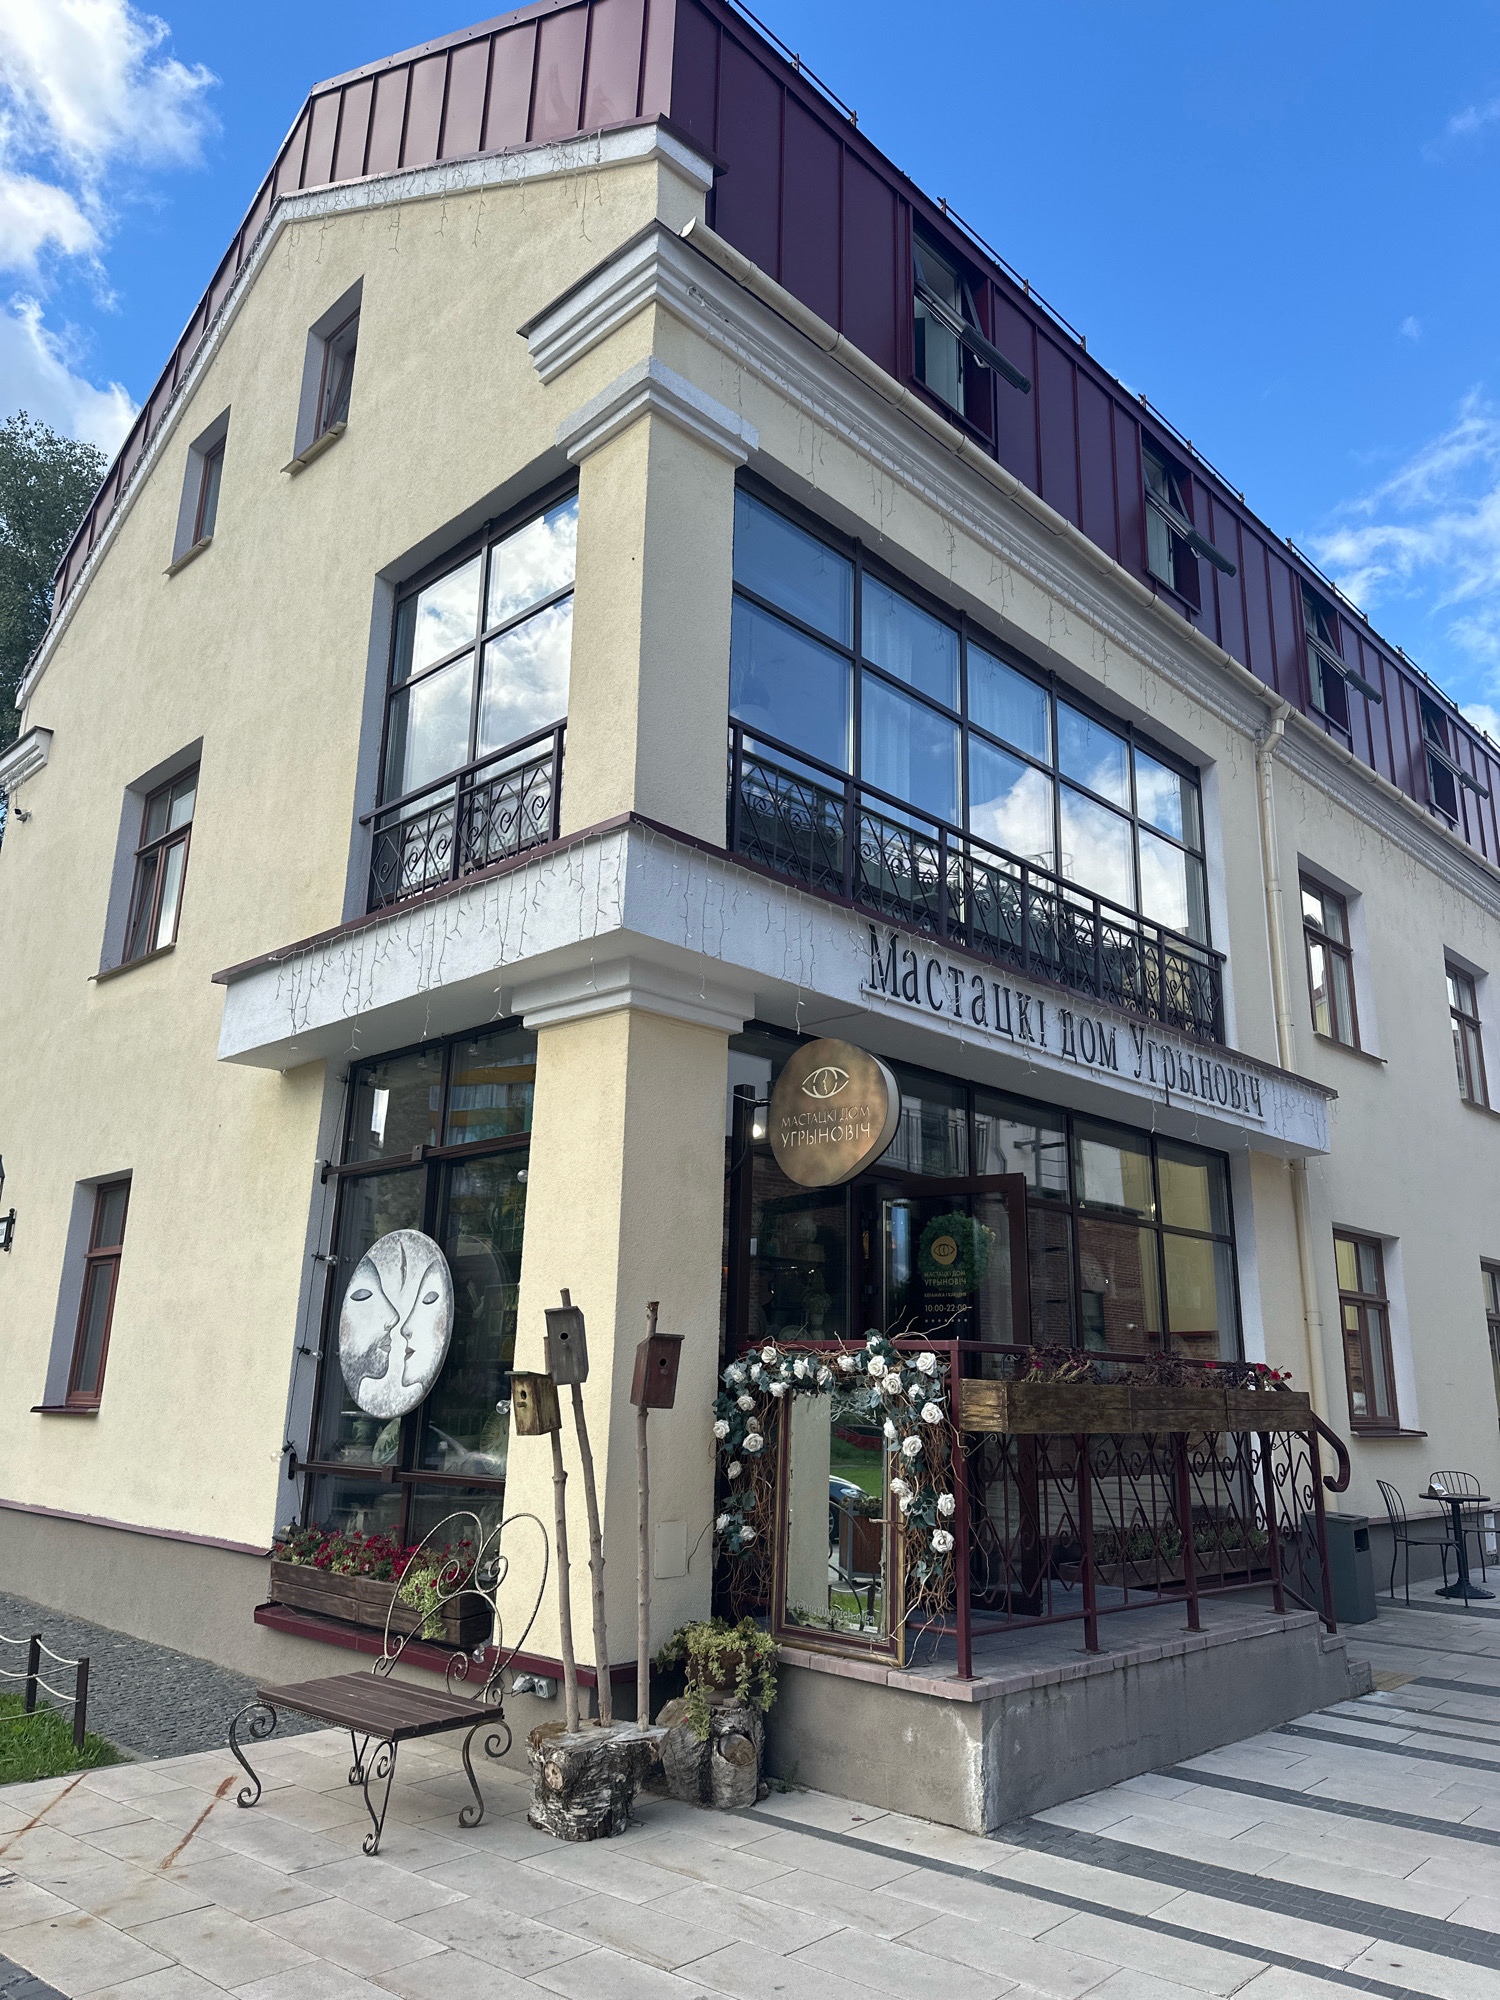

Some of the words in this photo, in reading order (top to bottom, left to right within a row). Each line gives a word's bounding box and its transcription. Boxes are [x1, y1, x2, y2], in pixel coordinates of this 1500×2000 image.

[868, 923, 1048, 1048] Мастацкі
[1058, 1008, 1119, 1072] дом
[1129, 1023, 1264, 1118] Угрыновіч
[780, 1109, 837, 1129] МАСТАЦКІ
[840, 1105, 870, 1122] ДОМ
[781, 1122, 871, 1148] УГРЫНОВІЧ
[924, 1278, 967, 1286] УГРЫНОВІЧ
[924, 1303, 967, 1312] 10:00-22:00
